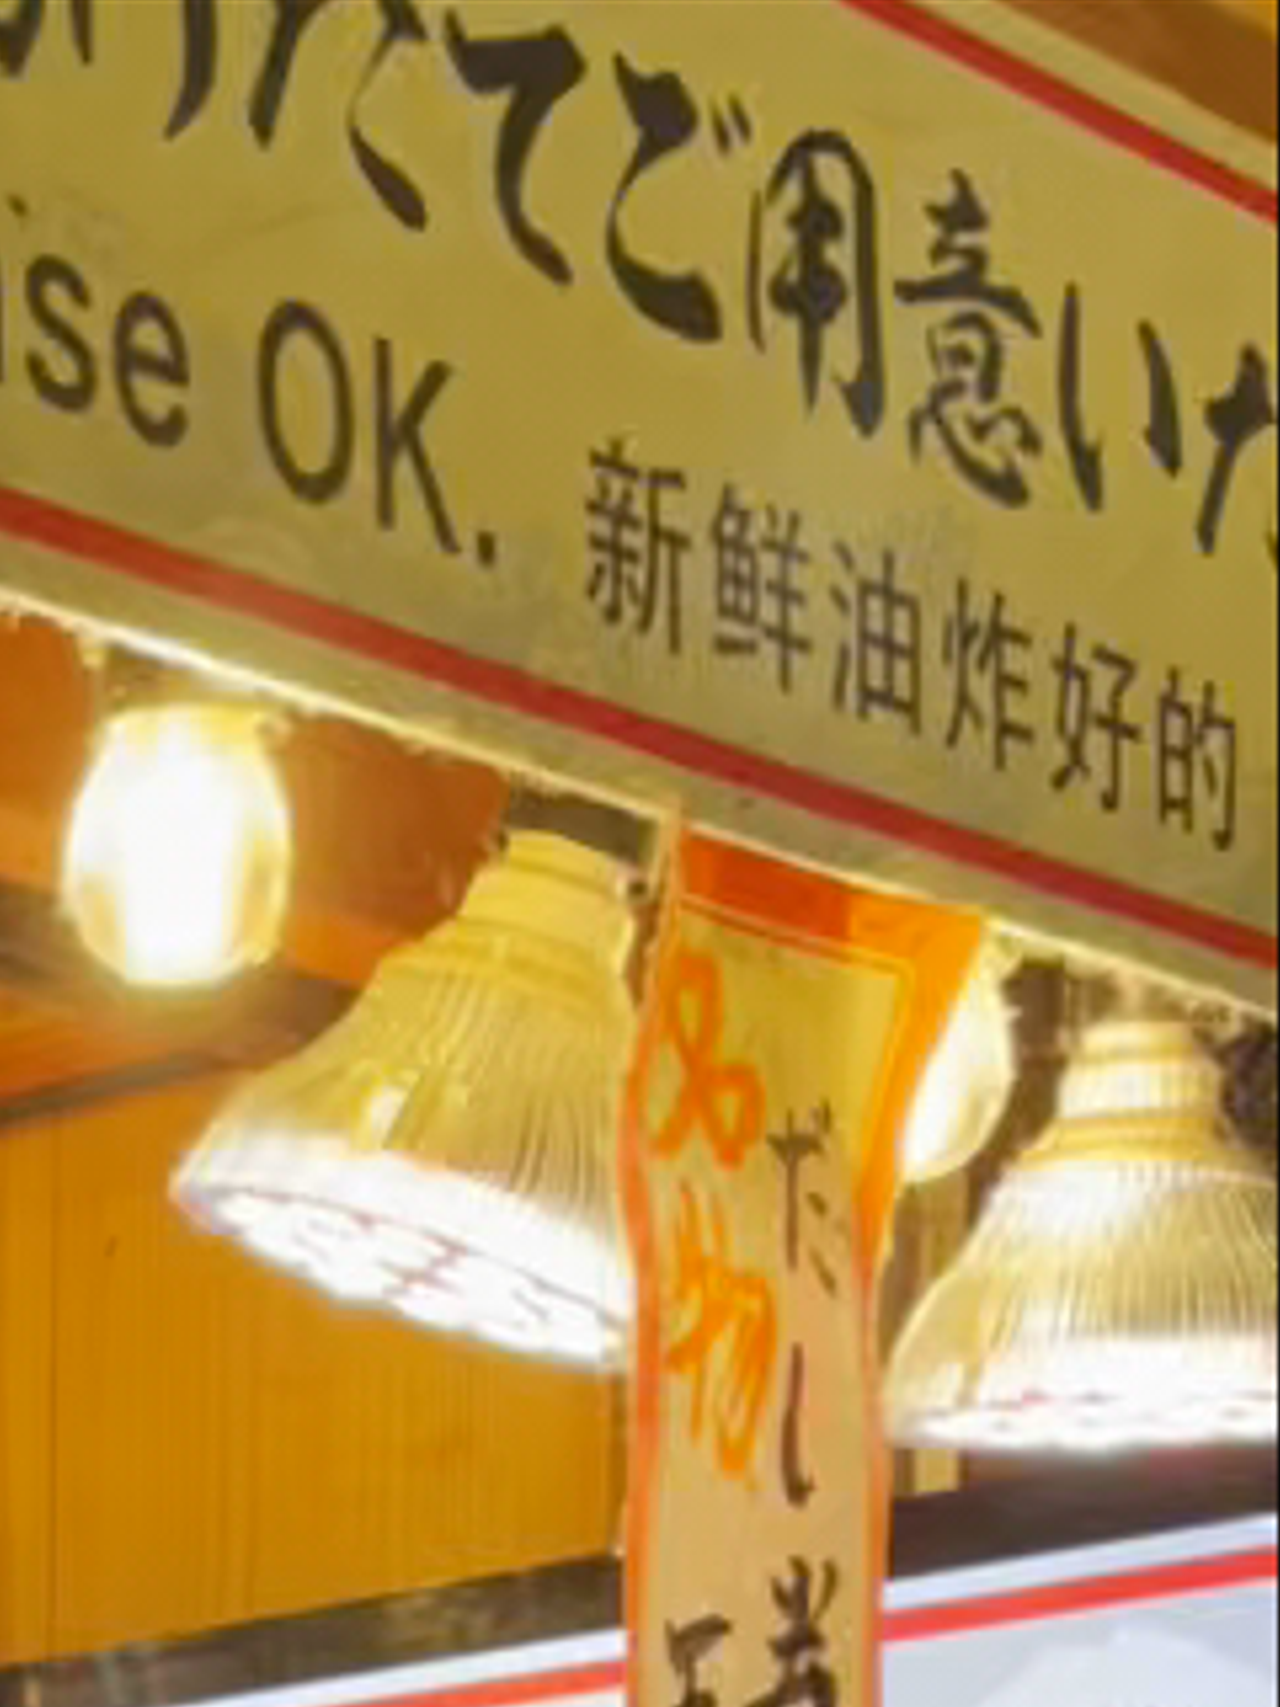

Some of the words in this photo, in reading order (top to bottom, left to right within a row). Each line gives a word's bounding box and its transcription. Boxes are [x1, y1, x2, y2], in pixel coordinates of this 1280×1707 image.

[258, 298, 497, 565] OK.
[583, 438, 1238, 852] 新鲜油炸好的
